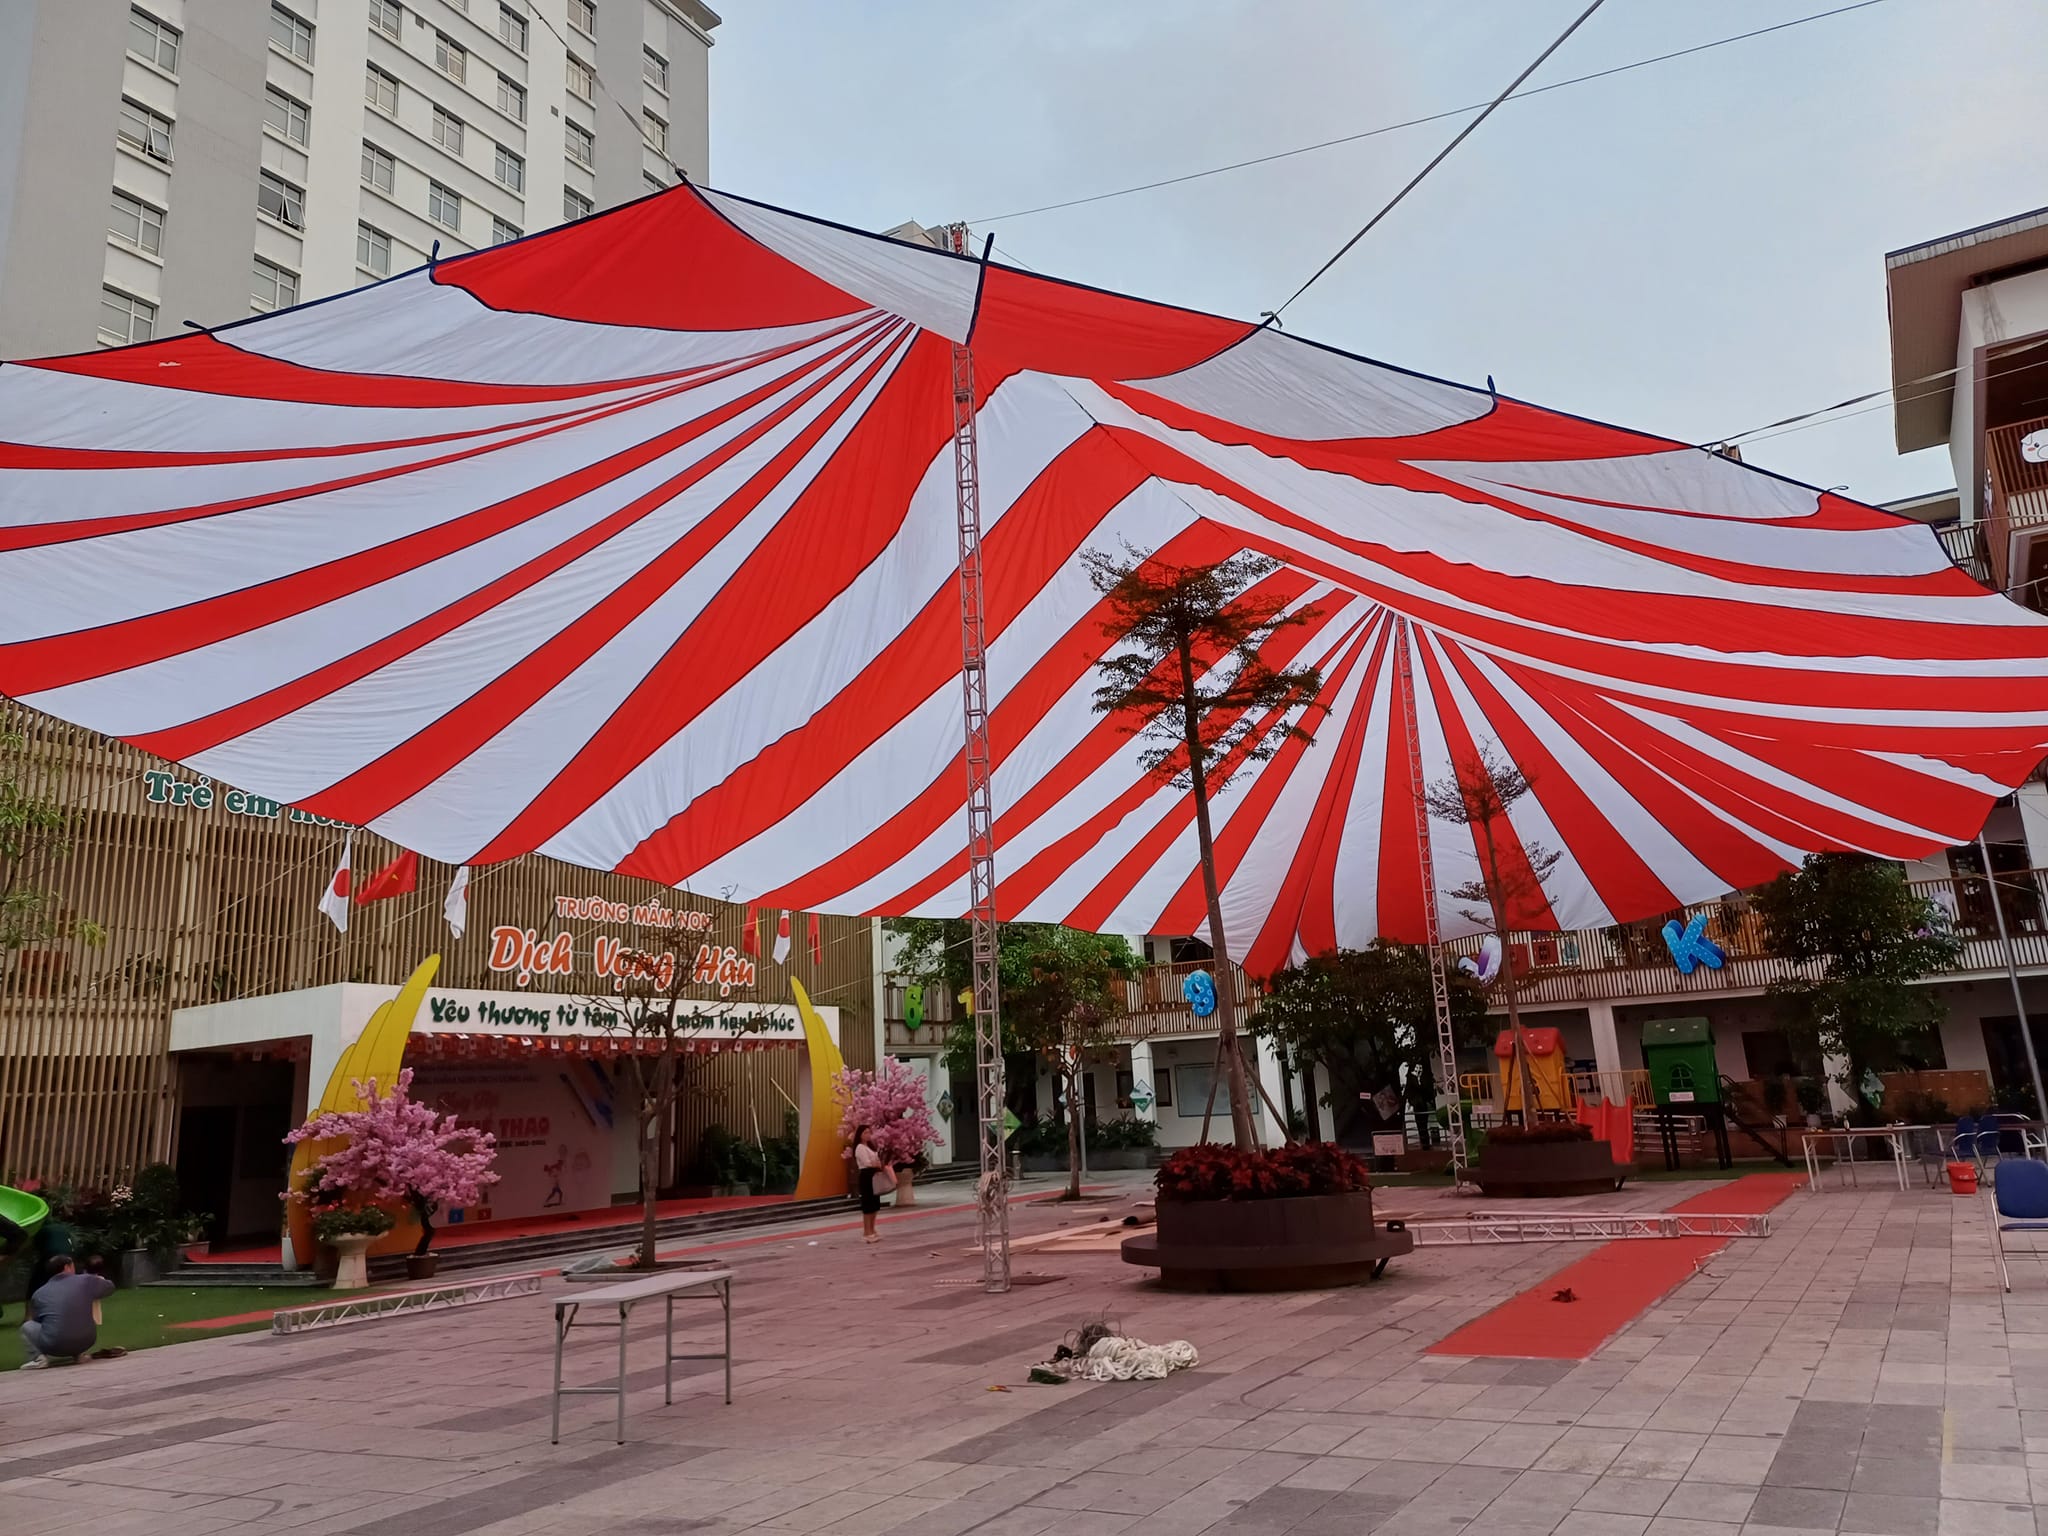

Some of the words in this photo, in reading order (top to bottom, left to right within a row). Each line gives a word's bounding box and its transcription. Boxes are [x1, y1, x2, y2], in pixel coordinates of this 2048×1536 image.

[144, 770, 214, 809] Trẻ
[224, 789, 280, 819] em
[555, 895, 629, 924] TRƯỜNG
[677, 909, 713, 933] NON
[488, 925, 573, 987] Dịch
[595, 936, 675, 992] Vọng
[1661, 913, 1726, 975] K
[430, 997, 470, 1023] Yêu
[478, 1000, 551, 1033] thương
[556, 1003, 579, 1027] từ
[583, 1006, 618, 1028] tâm
[1183, 969, 1217, 1017] 9
